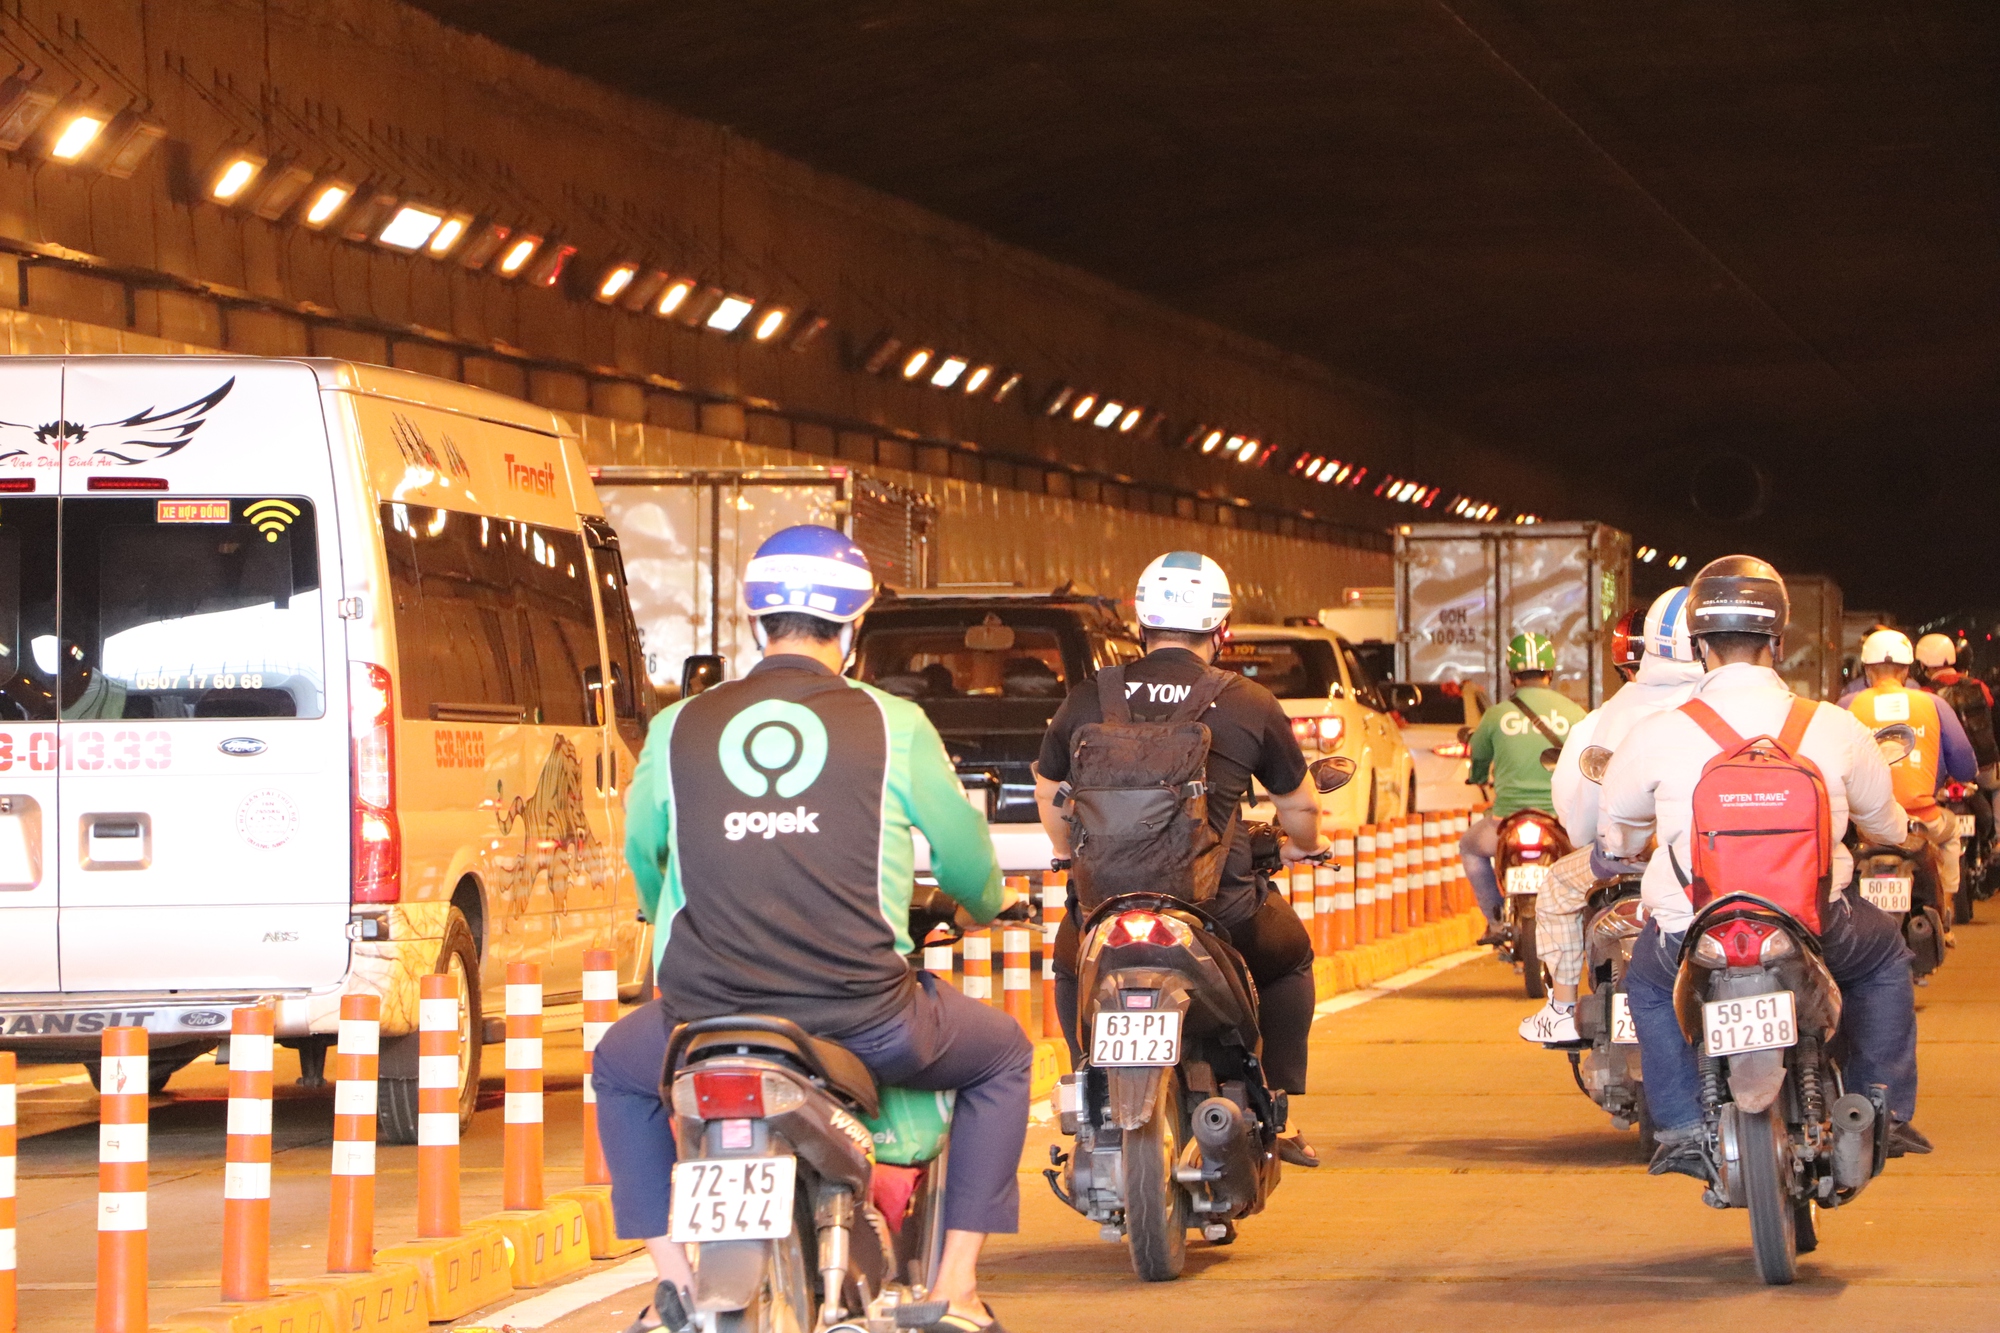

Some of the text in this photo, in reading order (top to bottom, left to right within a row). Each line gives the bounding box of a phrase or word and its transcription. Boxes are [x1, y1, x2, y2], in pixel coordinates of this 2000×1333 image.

[504, 453, 556, 499] Transit
[163, 506, 176, 518] XE
[178, 505, 197, 520] HỢP
[136, 673, 263, 690] 0907 17 60 68
[1147, 683, 1192, 703] YON
[1718, 793, 1753, 803] TOPTEN
[723, 806, 820, 841] gojek
[262, 930, 300, 943] ABS
[0, 1011, 219, 1035] ANSIT Ford
[1717, 997, 1777, 1026] 59-G1
[1106, 1014, 1166, 1036] 63-P1
[1711, 1019, 1790, 1051] 912.88
[1096, 1039, 1175, 1063] 201.23
[830, 1108, 871, 1149] Wave
[691, 1161, 776, 1198] 72-K5
[688, 1200, 773, 1232] 4544
